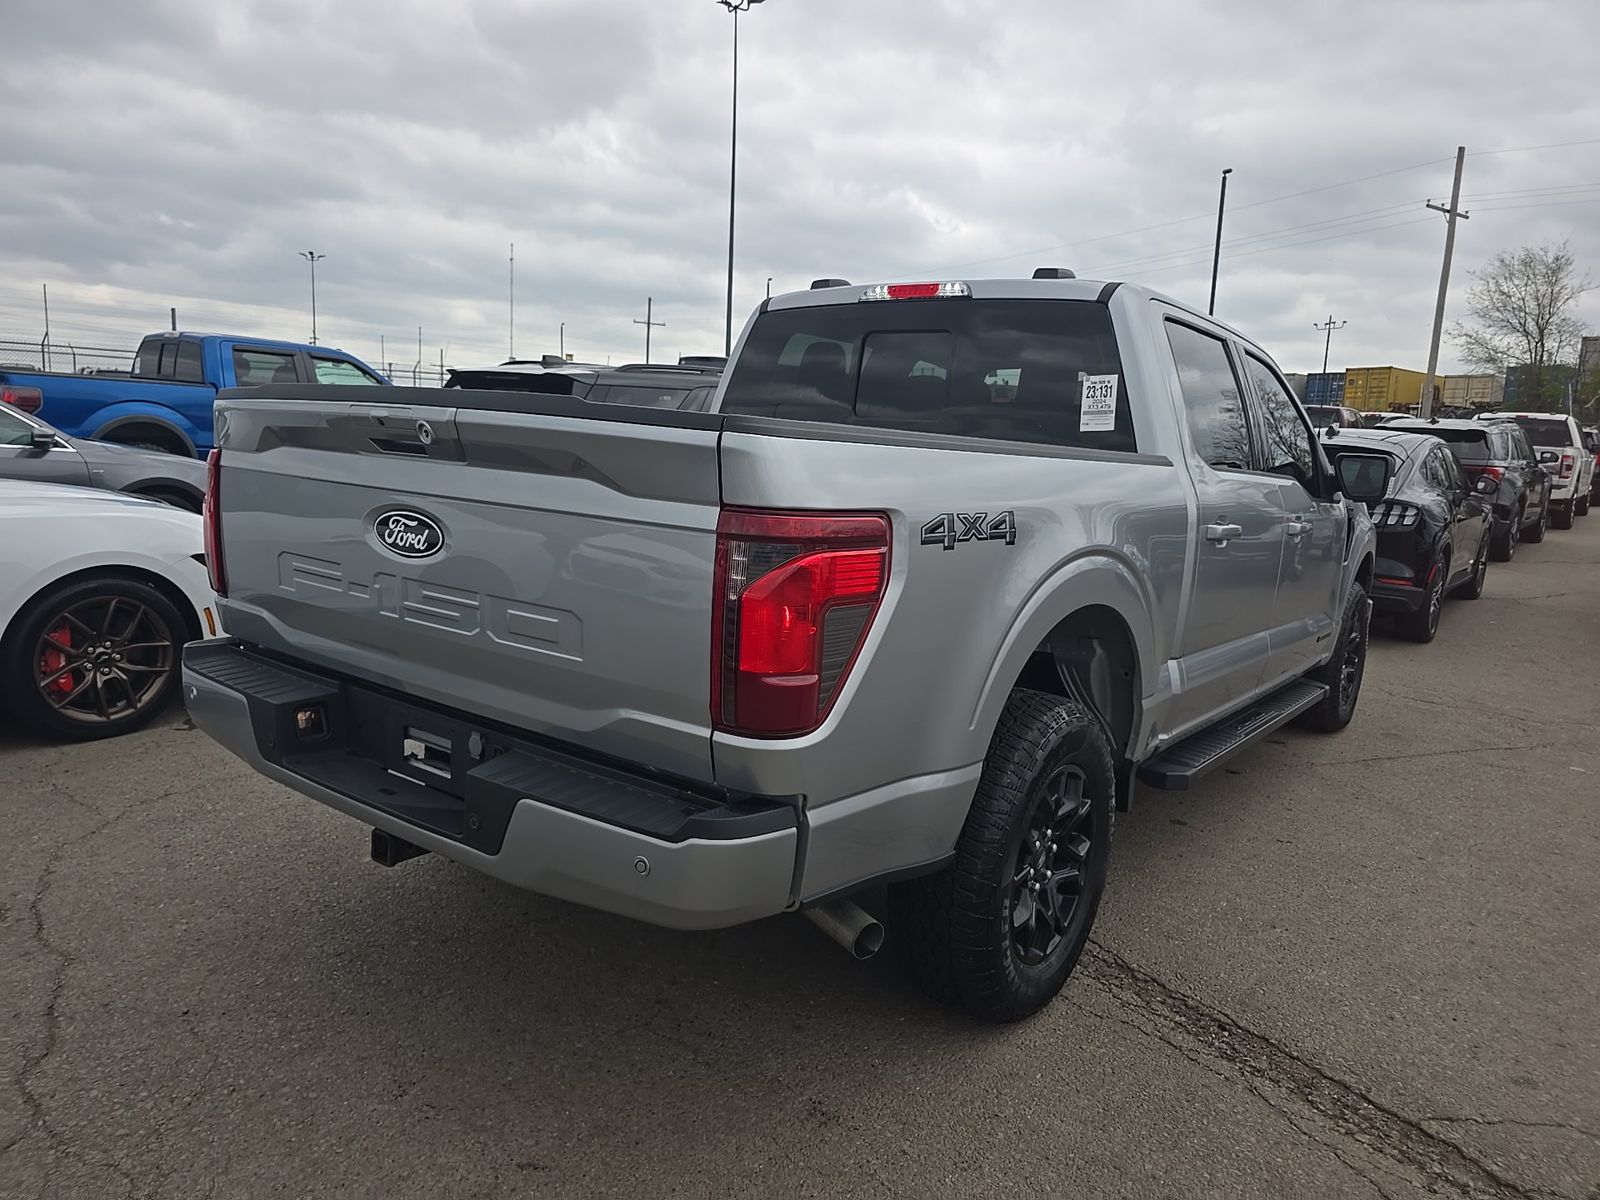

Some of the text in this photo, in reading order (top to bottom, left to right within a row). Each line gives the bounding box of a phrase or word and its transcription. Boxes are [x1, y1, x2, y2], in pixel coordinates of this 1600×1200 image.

[1086, 385, 1113, 399] 23:131
[384, 515, 430, 551] Ford
[277, 550, 584, 662] F-150
